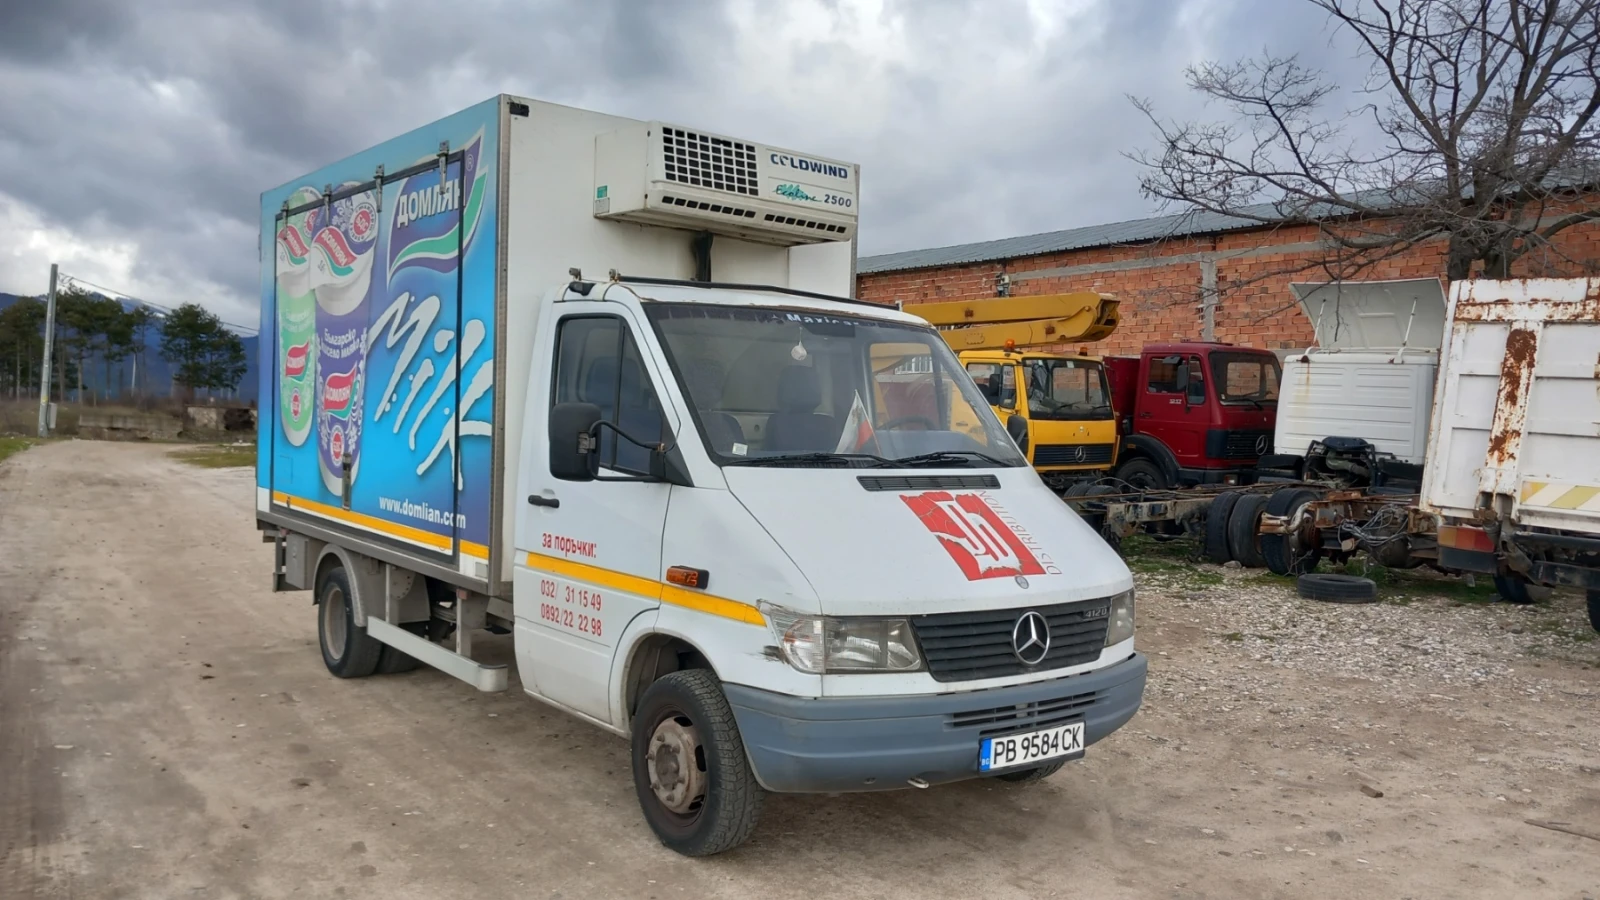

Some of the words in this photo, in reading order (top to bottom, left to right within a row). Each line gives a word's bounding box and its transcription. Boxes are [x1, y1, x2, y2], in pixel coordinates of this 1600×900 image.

[396, 175, 467, 229] ДОМЛЯН
[824, 194, 852, 208] 2500
[366, 291, 493, 491] Milk
[542, 532, 552, 549] за
[554, 535, 597, 559] поръчки:
[565, 585, 575, 604] 31
[578, 589, 588, 608] 15
[590, 593, 602, 612] 49
[578, 613, 589, 633] 22
[591, 617, 602, 637] 98
[993, 739, 1017, 765] PB
[1021, 731, 1059, 760] 9584
[1062, 726, 1081, 751] CK
